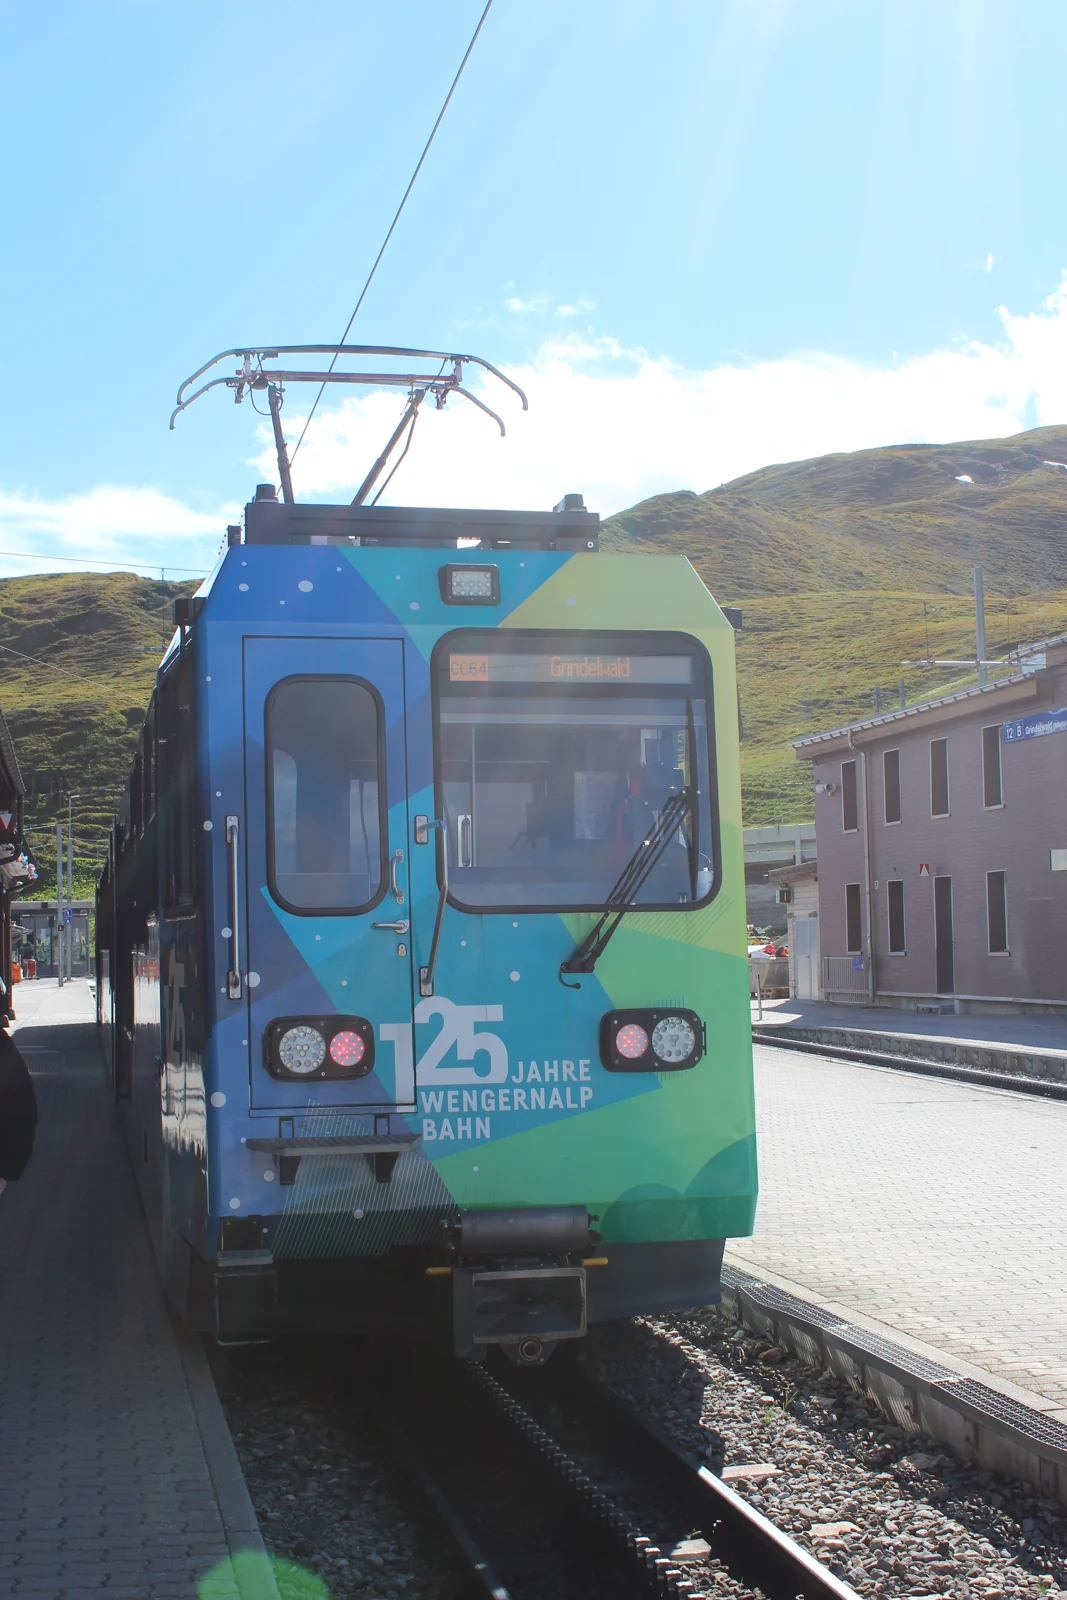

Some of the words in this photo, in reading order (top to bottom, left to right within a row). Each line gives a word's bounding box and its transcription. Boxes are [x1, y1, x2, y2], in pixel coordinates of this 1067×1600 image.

[550, 656, 630, 677] Grindelwald
[1006, 727, 1013, 739] 12
[1016, 725, 1022, 737] B
[379, 995, 509, 1113] 125
[511, 1059, 592, 1084] JAHRE
[420, 1086, 594, 1113] WENGERNALP
[422, 1116, 491, 1141] BAHN
